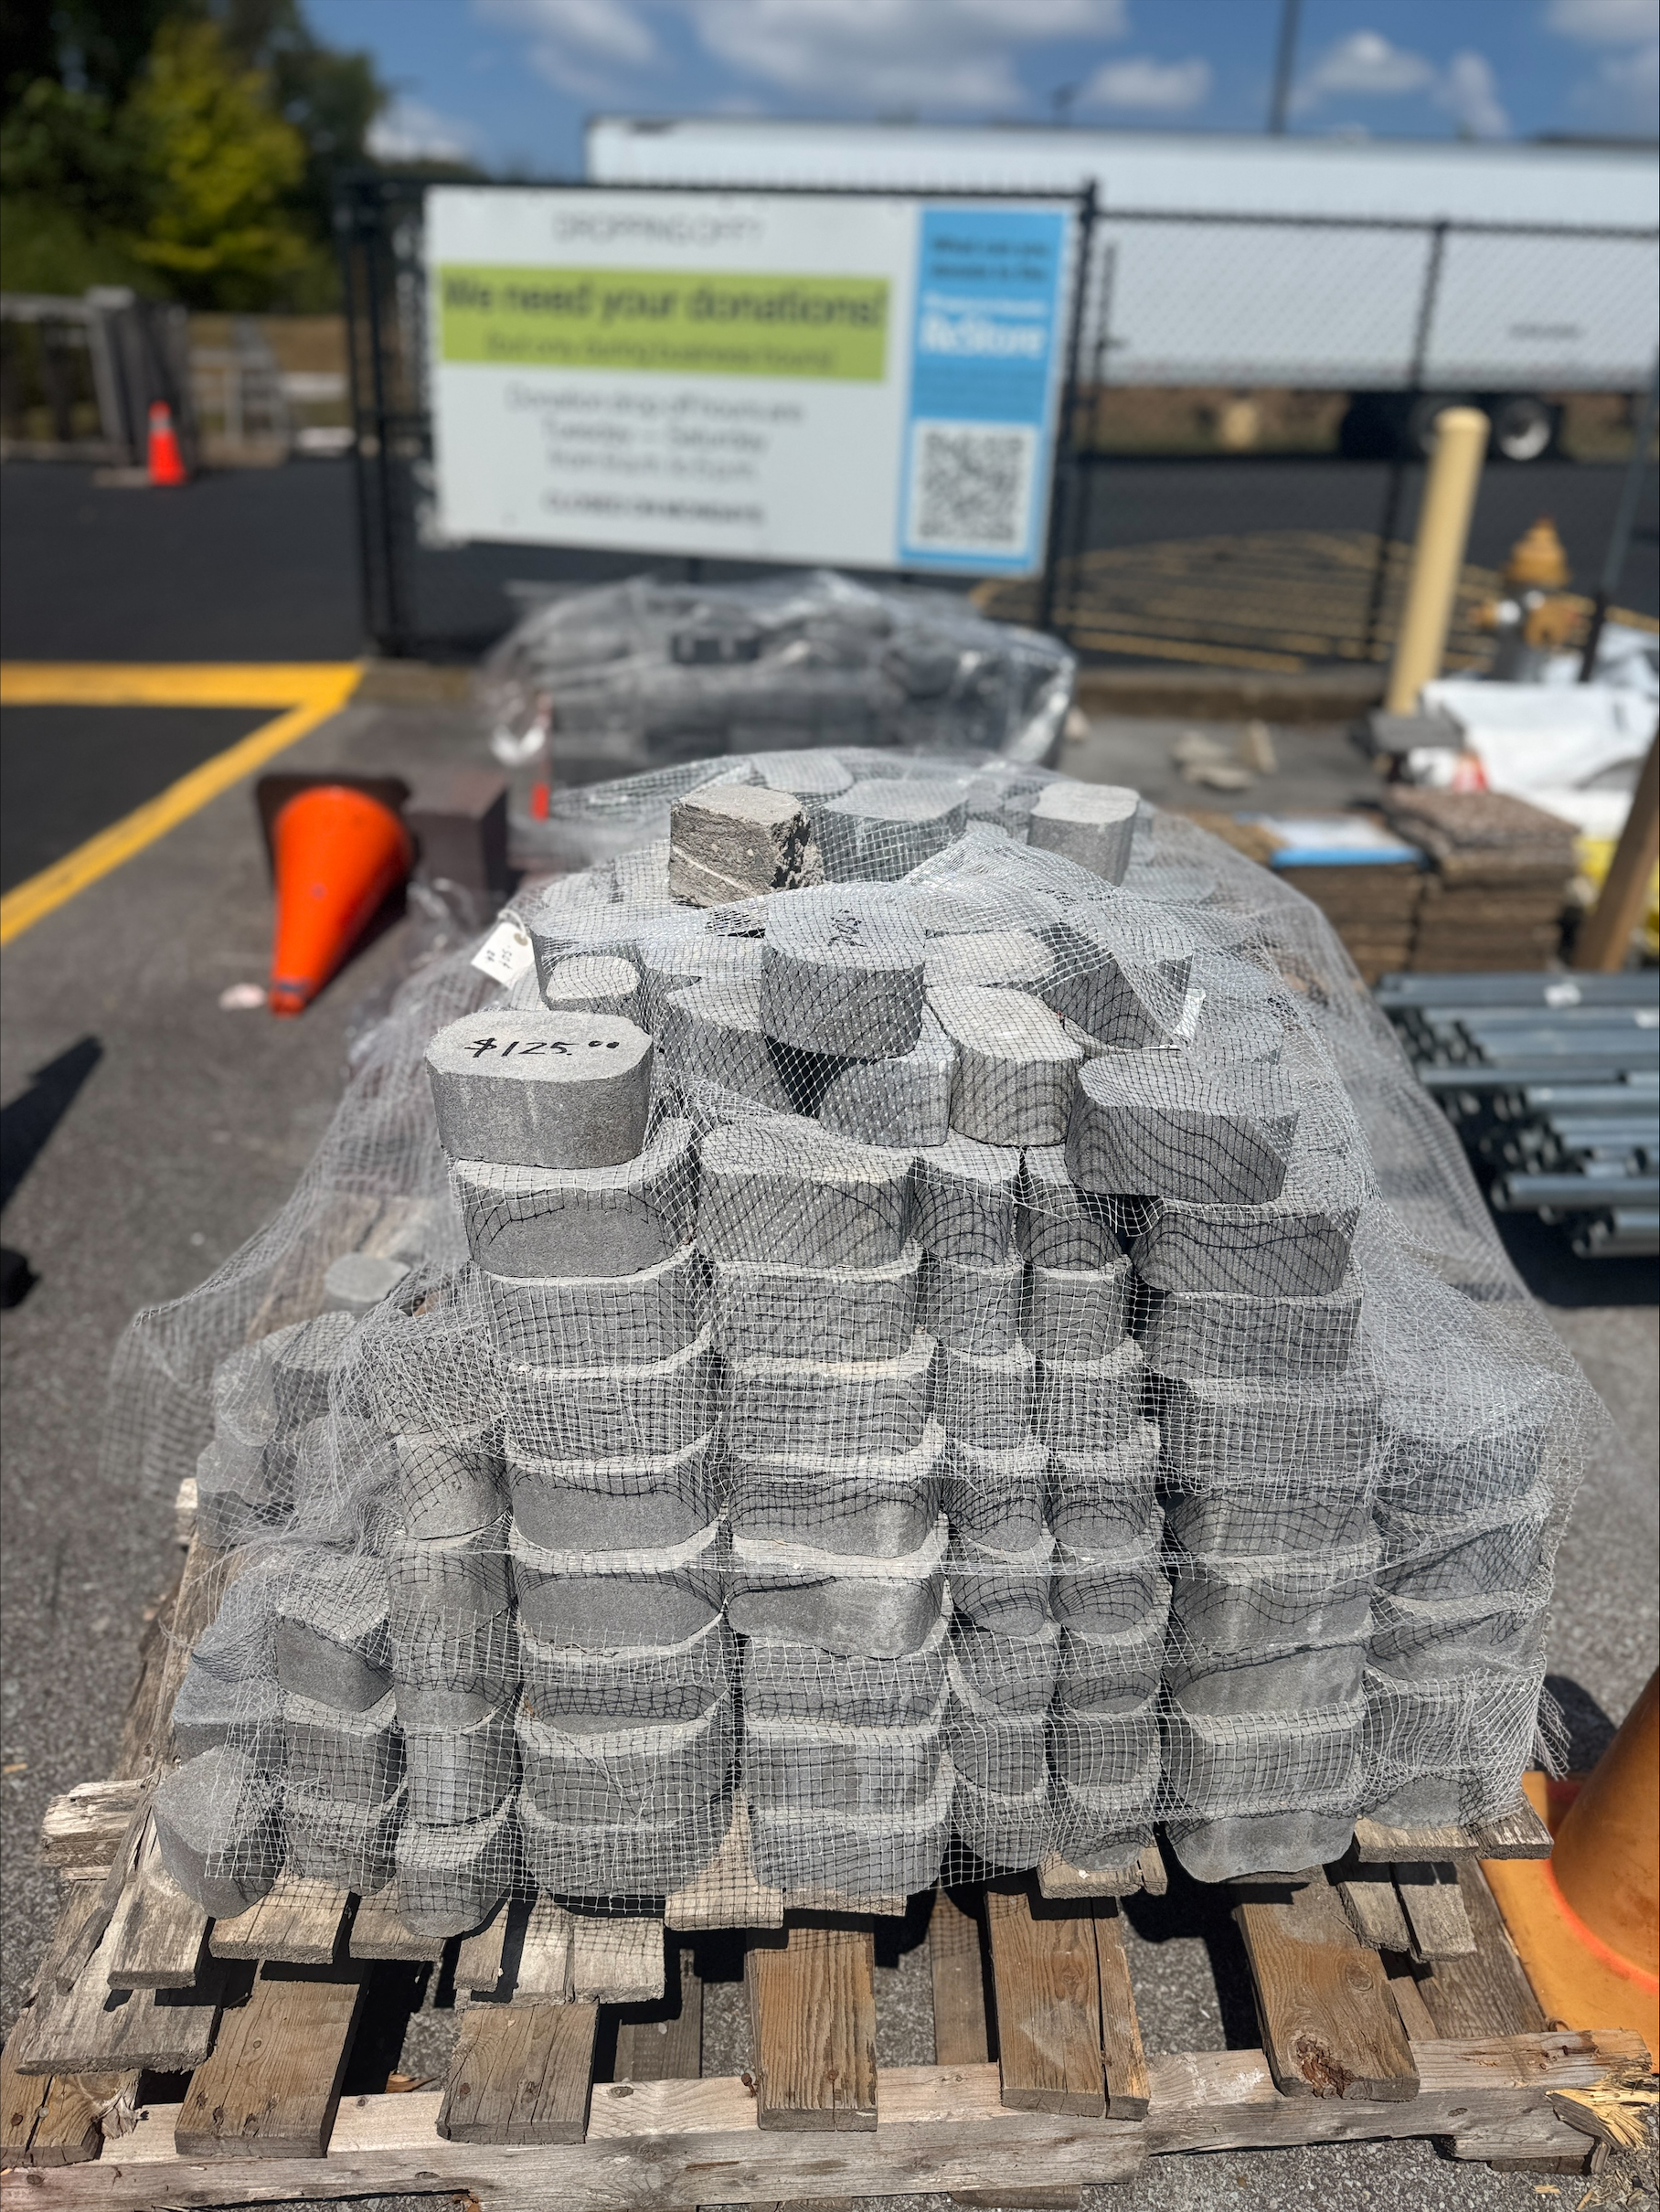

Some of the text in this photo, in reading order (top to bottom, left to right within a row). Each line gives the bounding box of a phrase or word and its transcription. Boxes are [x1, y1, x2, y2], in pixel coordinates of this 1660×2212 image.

[440, 275, 495, 313] We
[502, 280, 592, 318] need
[599, 288, 679, 325] your
[687, 284, 889, 329] donations!
